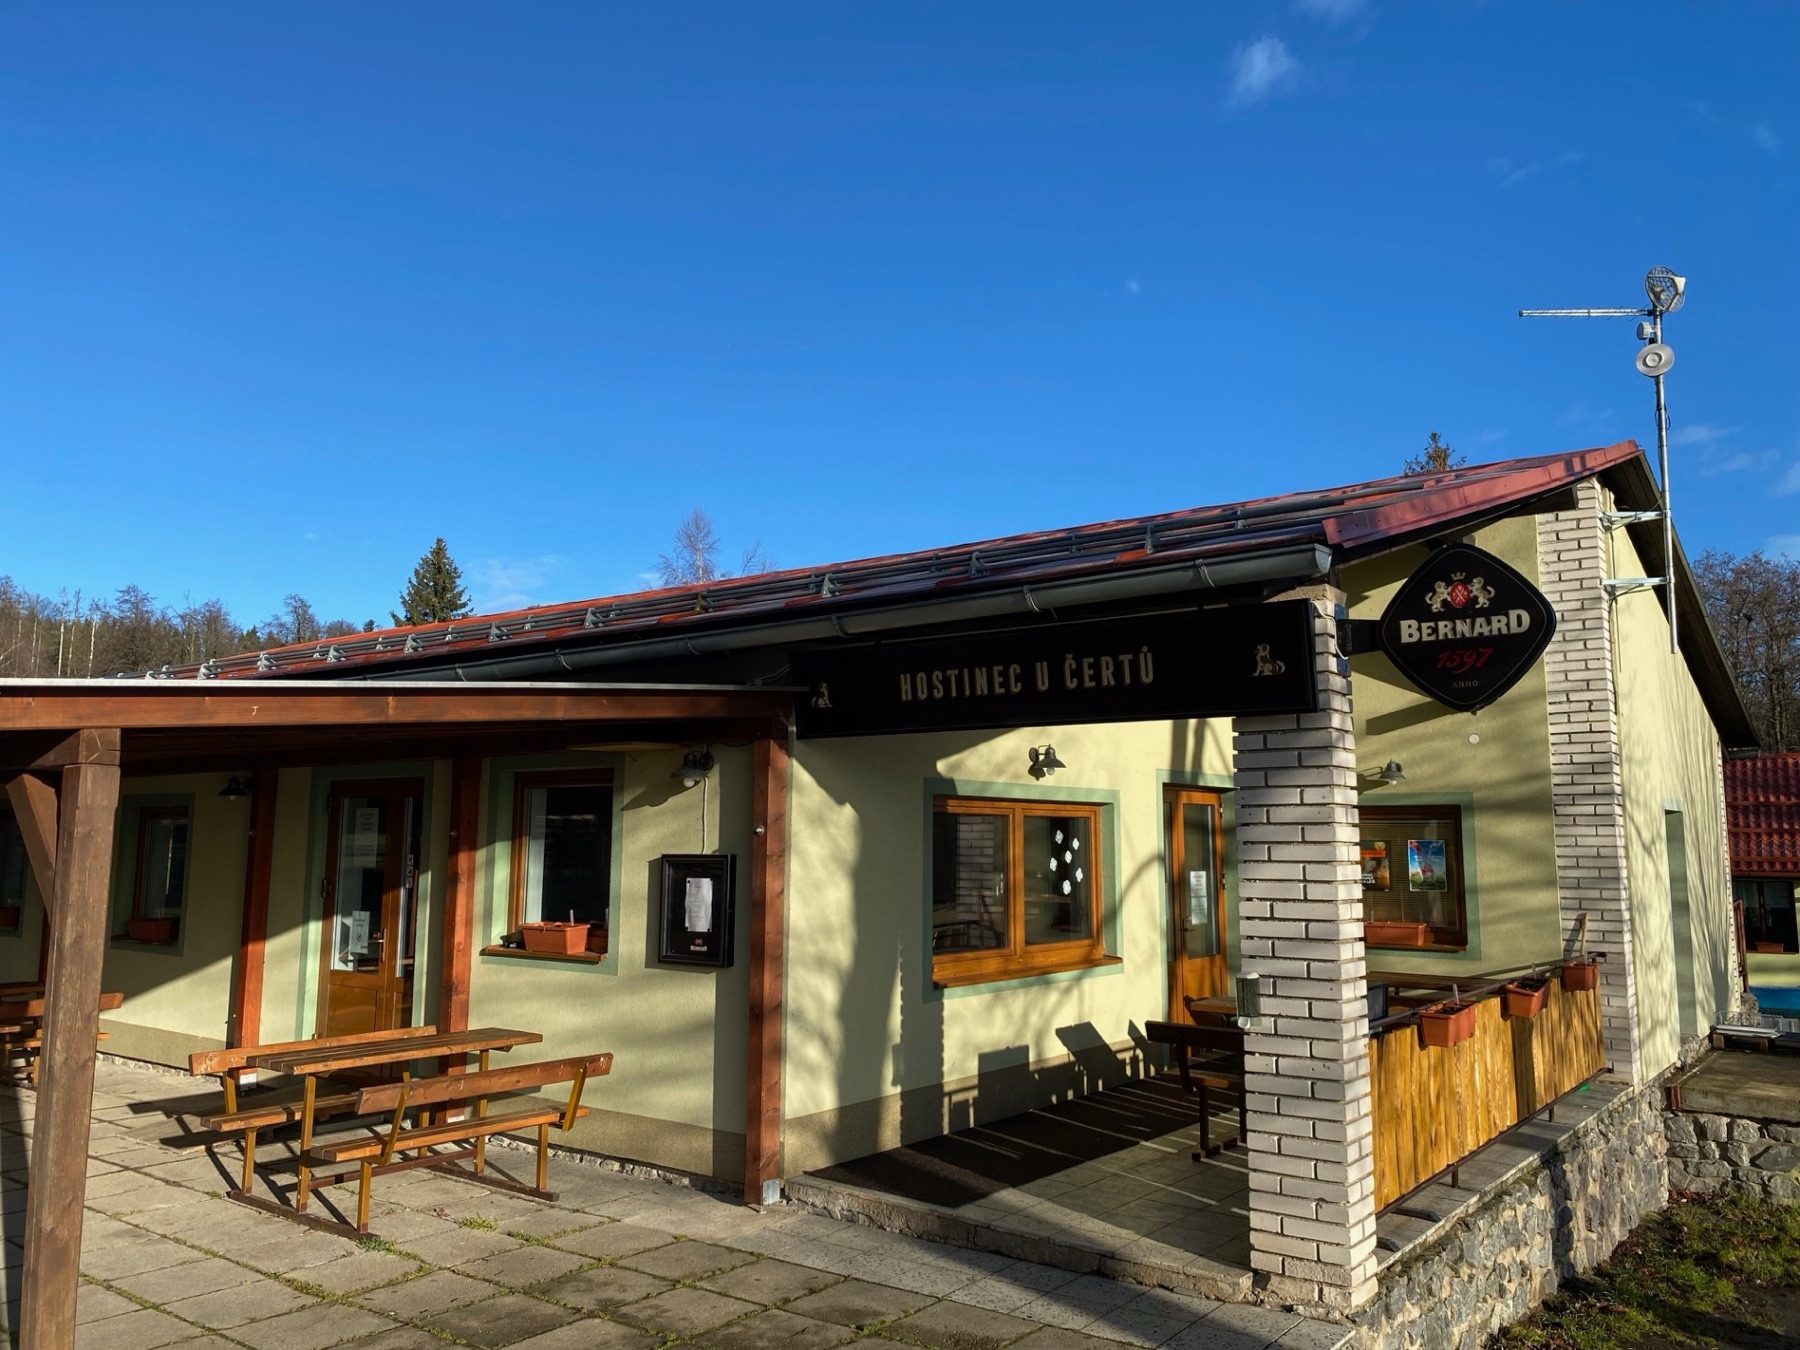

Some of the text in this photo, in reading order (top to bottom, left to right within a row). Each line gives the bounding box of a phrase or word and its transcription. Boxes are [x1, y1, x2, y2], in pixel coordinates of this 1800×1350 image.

[1400, 609, 1530, 643] BERNARD
[900, 645, 1153, 701] HOSTINEC U ČERTŮ
[1435, 647, 1493, 673] 1597
[1452, 680, 1478, 688] ANNO
